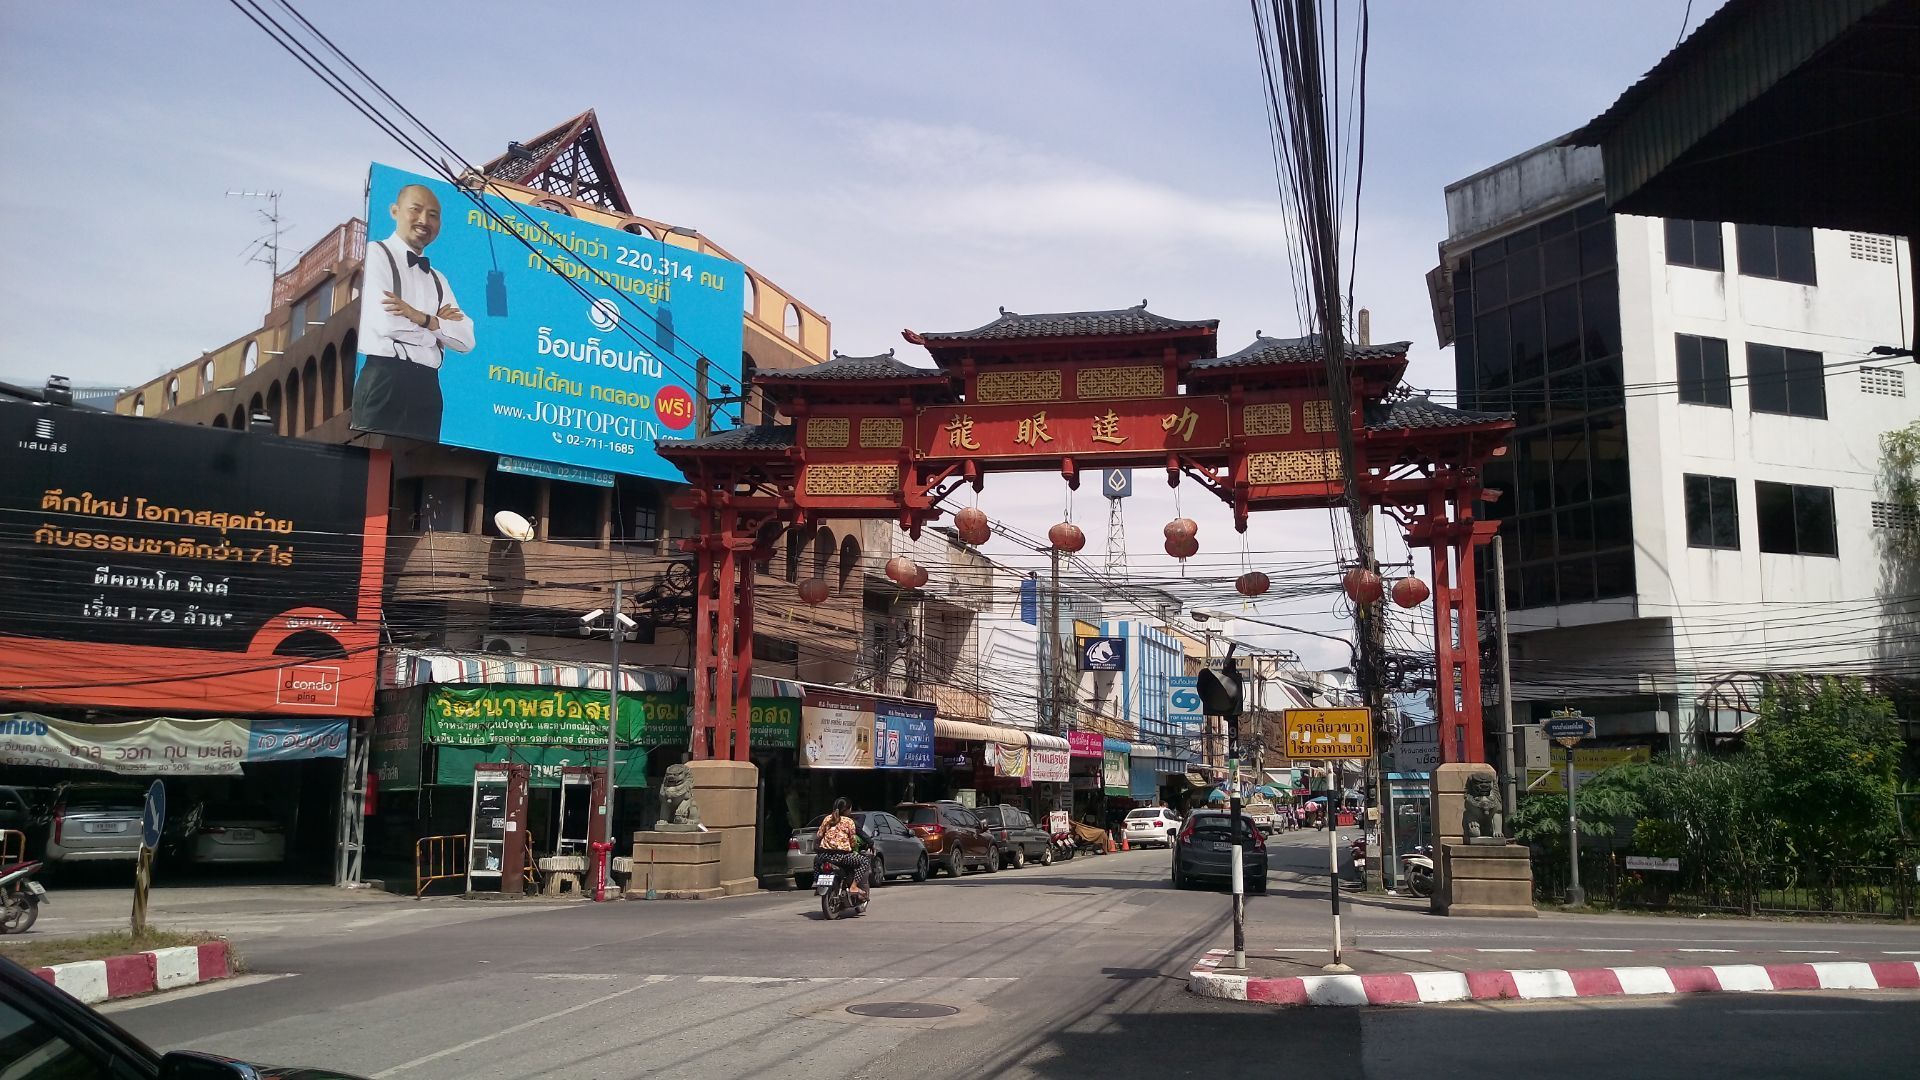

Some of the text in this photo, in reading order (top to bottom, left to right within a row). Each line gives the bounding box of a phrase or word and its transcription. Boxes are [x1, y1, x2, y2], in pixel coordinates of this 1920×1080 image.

[615, 246, 694, 282] 220,314
[699, 270, 725, 291] คน
[488, 363, 692, 419] หาคนได้คน ทดลอง ฟรี!
[493, 400, 684, 441] www.JOBTOPGUN
[566, 433, 635, 455] 02-711-1685
[41, 488, 293, 535] ตึกใหม่ โอกาสสุดท้าย
[33, 522, 295, 567] กับธรรมชาติกว่า 7 ไร่
[126, 606, 176, 624] 1.79
[284, 670, 333, 691] dcondo
[296, 692, 317, 702] ping
[1296, 712, 1365, 734] รถเลี้ยวขวา
[114, 746, 151, 760] วอก
[164, 745, 189, 763] กุน
[197, 740, 243, 758] มะเส็ง
[1290, 738, 1369, 754] ใช้ช่องทางขวา
